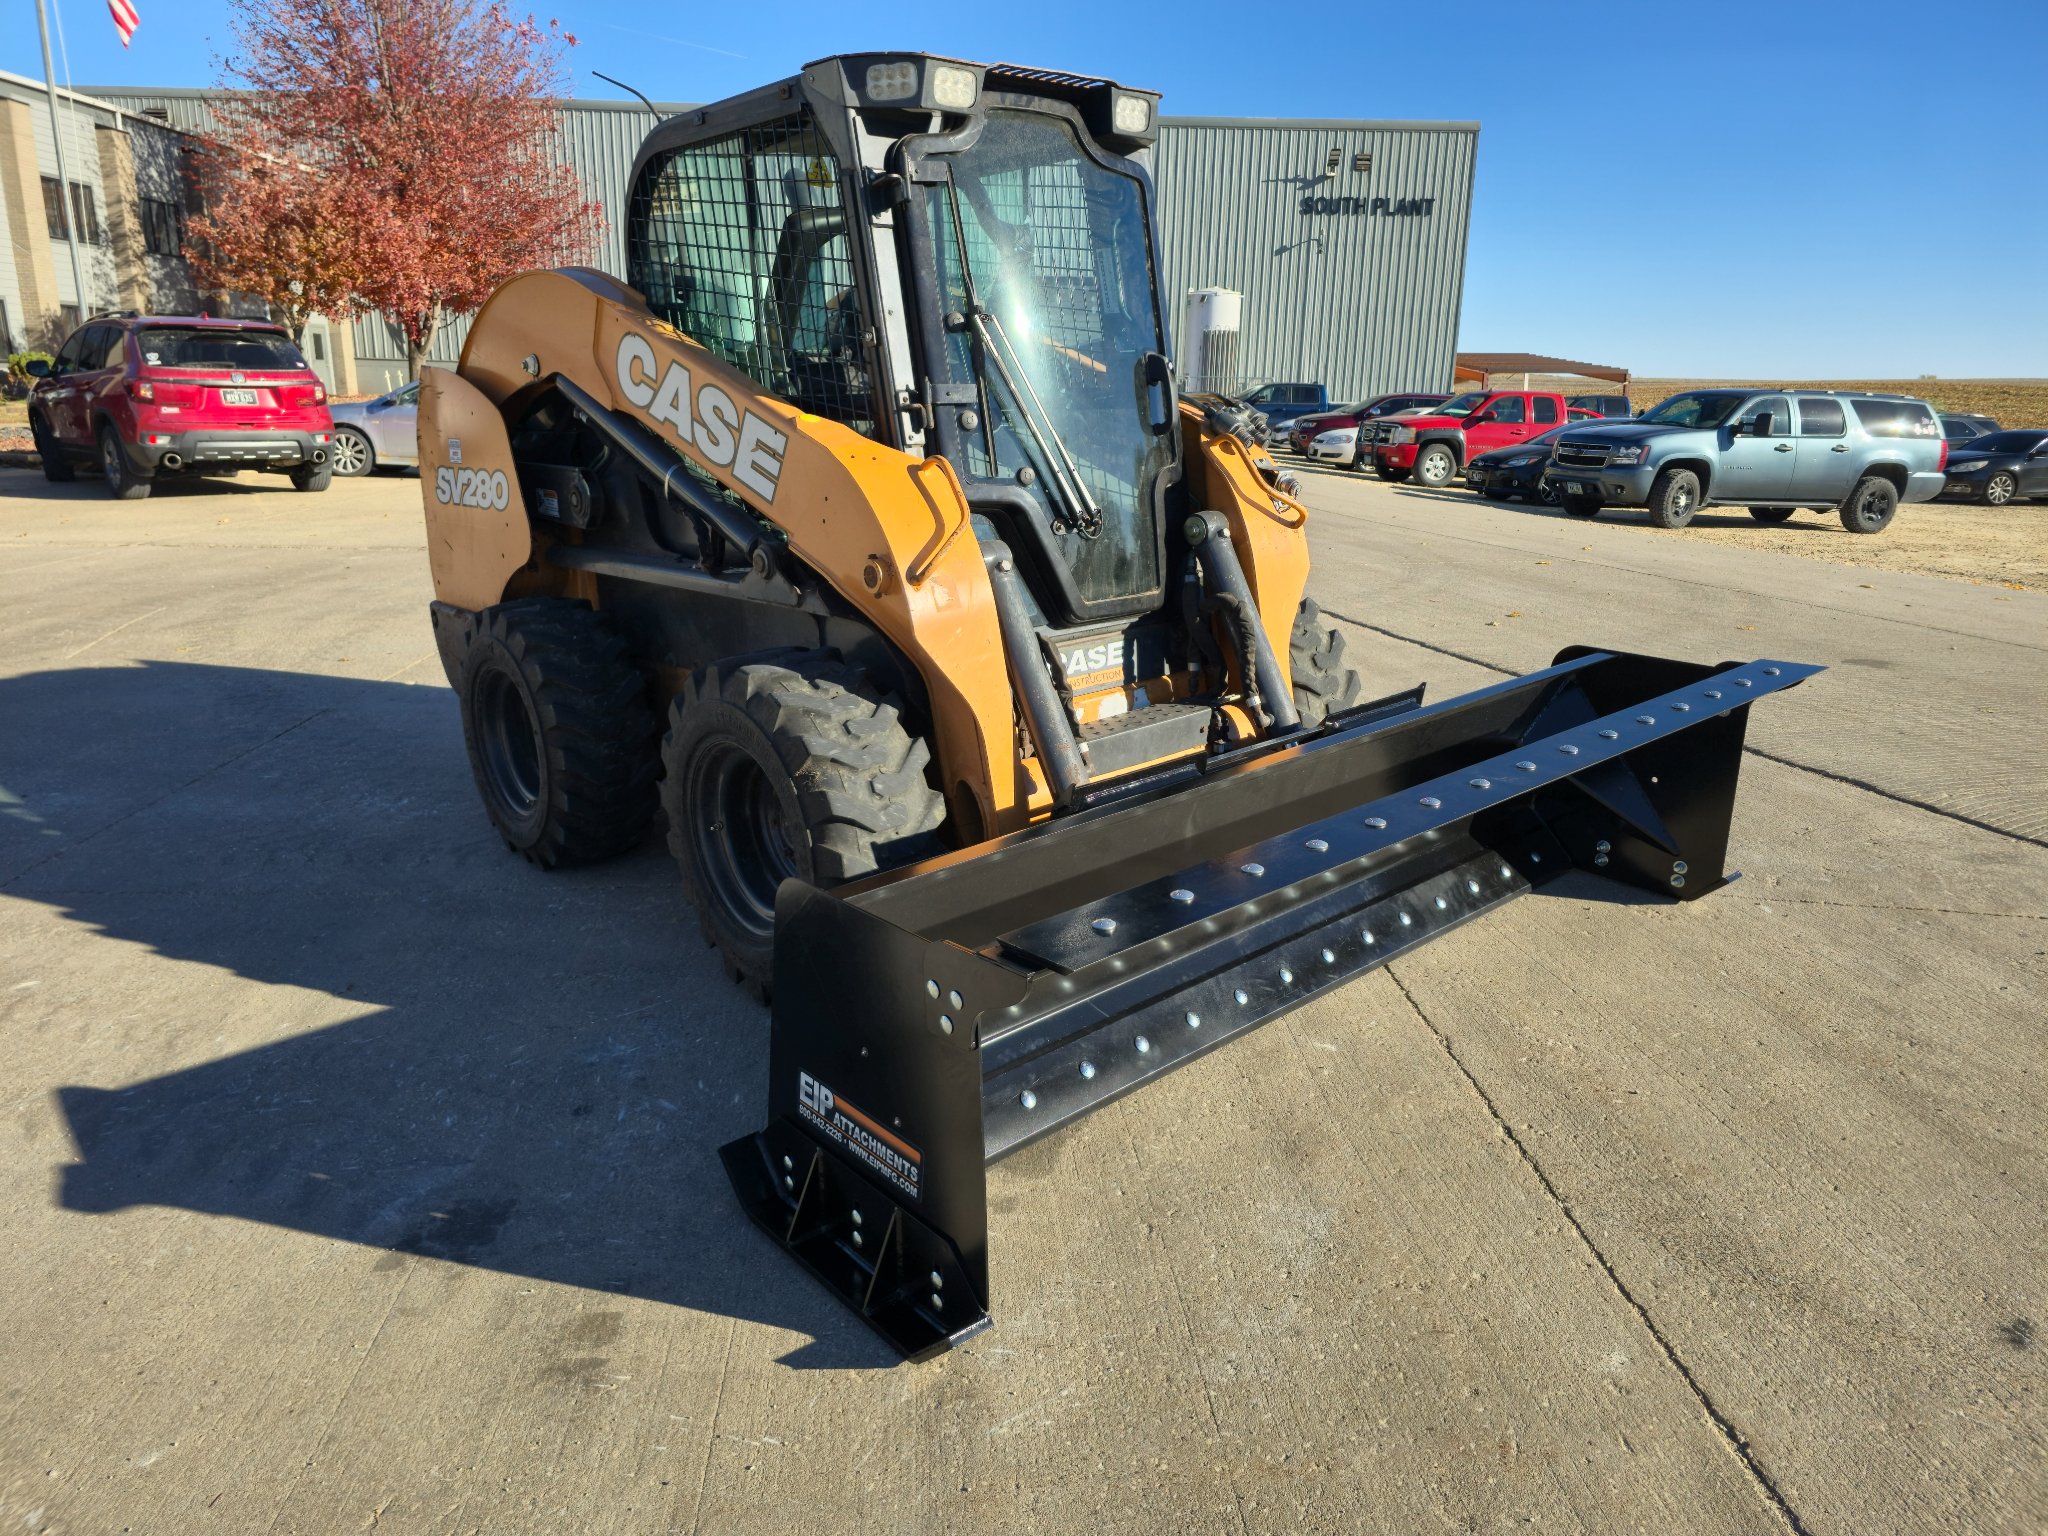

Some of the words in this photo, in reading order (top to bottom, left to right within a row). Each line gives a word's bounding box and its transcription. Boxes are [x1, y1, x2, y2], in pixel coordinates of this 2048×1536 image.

[1299, 197, 1366, 216] SOUTH
[1370, 198, 1435, 217] PLANT
[616, 331, 789, 505] CASE
[436, 465, 510, 512] SV280
[1070, 670, 1121, 687] NSTRUCTION
[800, 1071, 834, 1116] EIP
[799, 1104, 842, 1142] 800-942-2226
[848, 1139, 918, 1198] WWW.EIPMFG.COM
[833, 1112, 918, 1182] ATTACHMENTS
